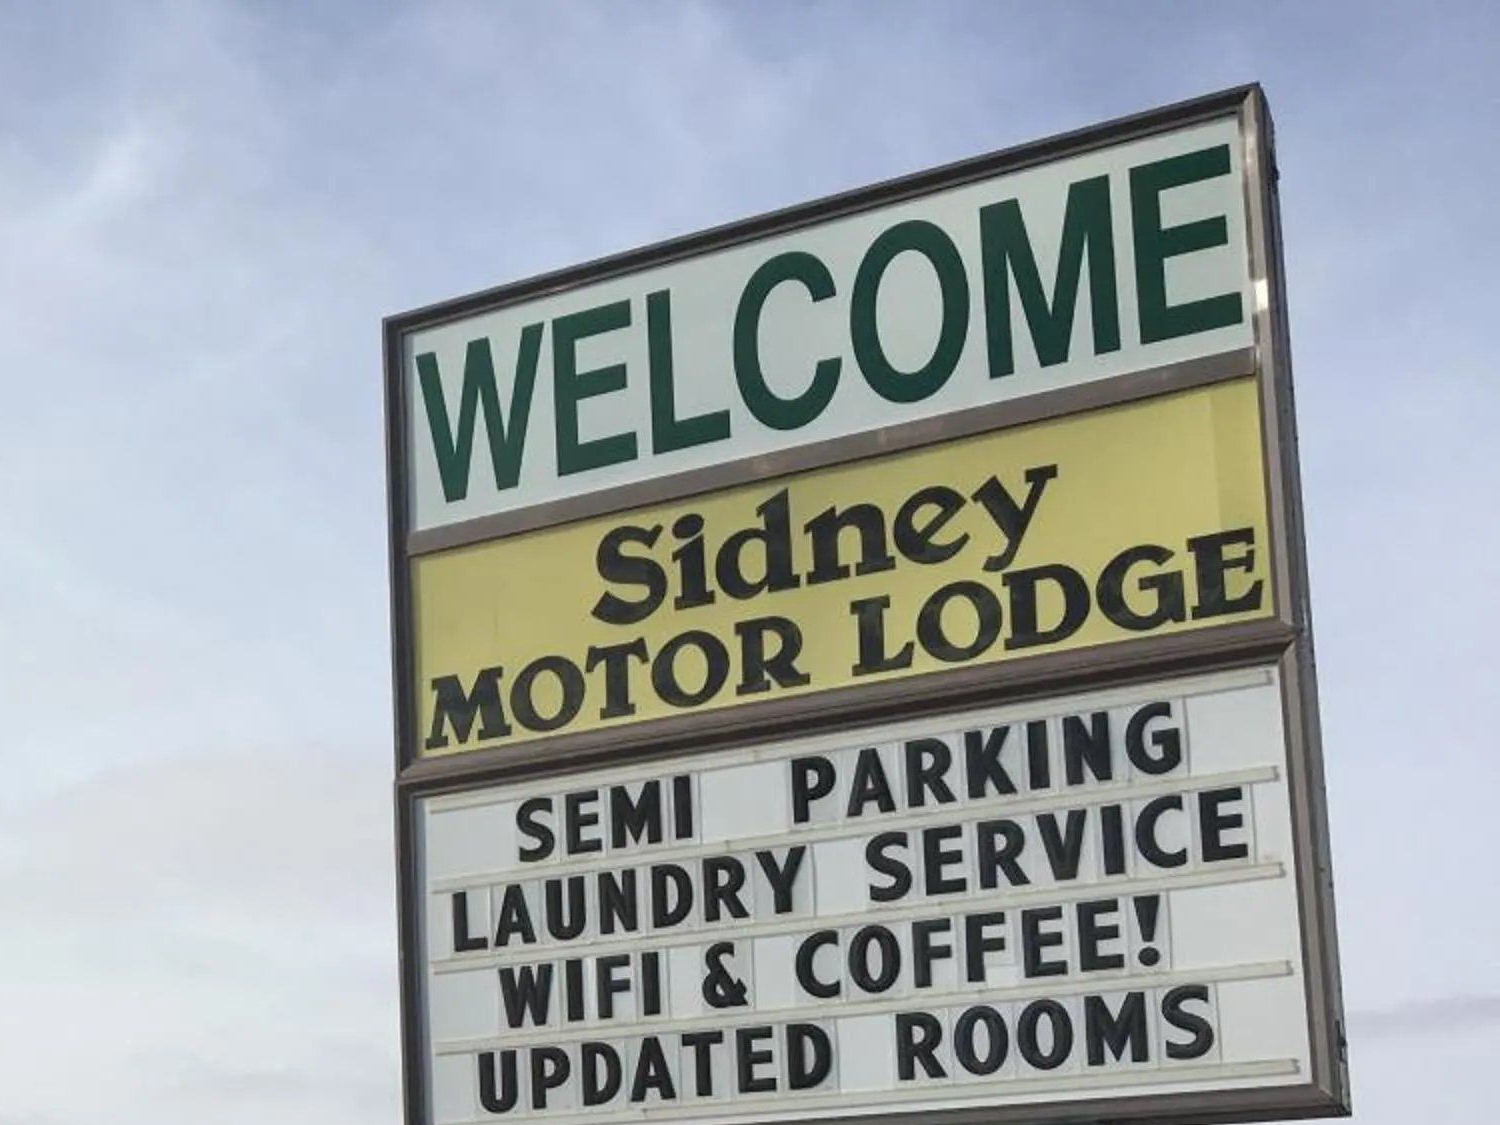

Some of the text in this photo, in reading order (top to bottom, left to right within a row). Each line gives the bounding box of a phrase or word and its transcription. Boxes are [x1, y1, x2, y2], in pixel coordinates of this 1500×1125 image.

[415, 143, 1244, 504] WELCOME
[591, 464, 1059, 625] Sidney
[425, 527, 1264, 750] MOTOR LODGE
[516, 701, 1183, 864] SEMI PARKING
[452, 786, 1251, 953] LAUNDRY SERVICE
[498, 894, 1163, 1029] WIFI & COFFEE!
[476, 984, 1216, 1114] UPDATED ROOMS
